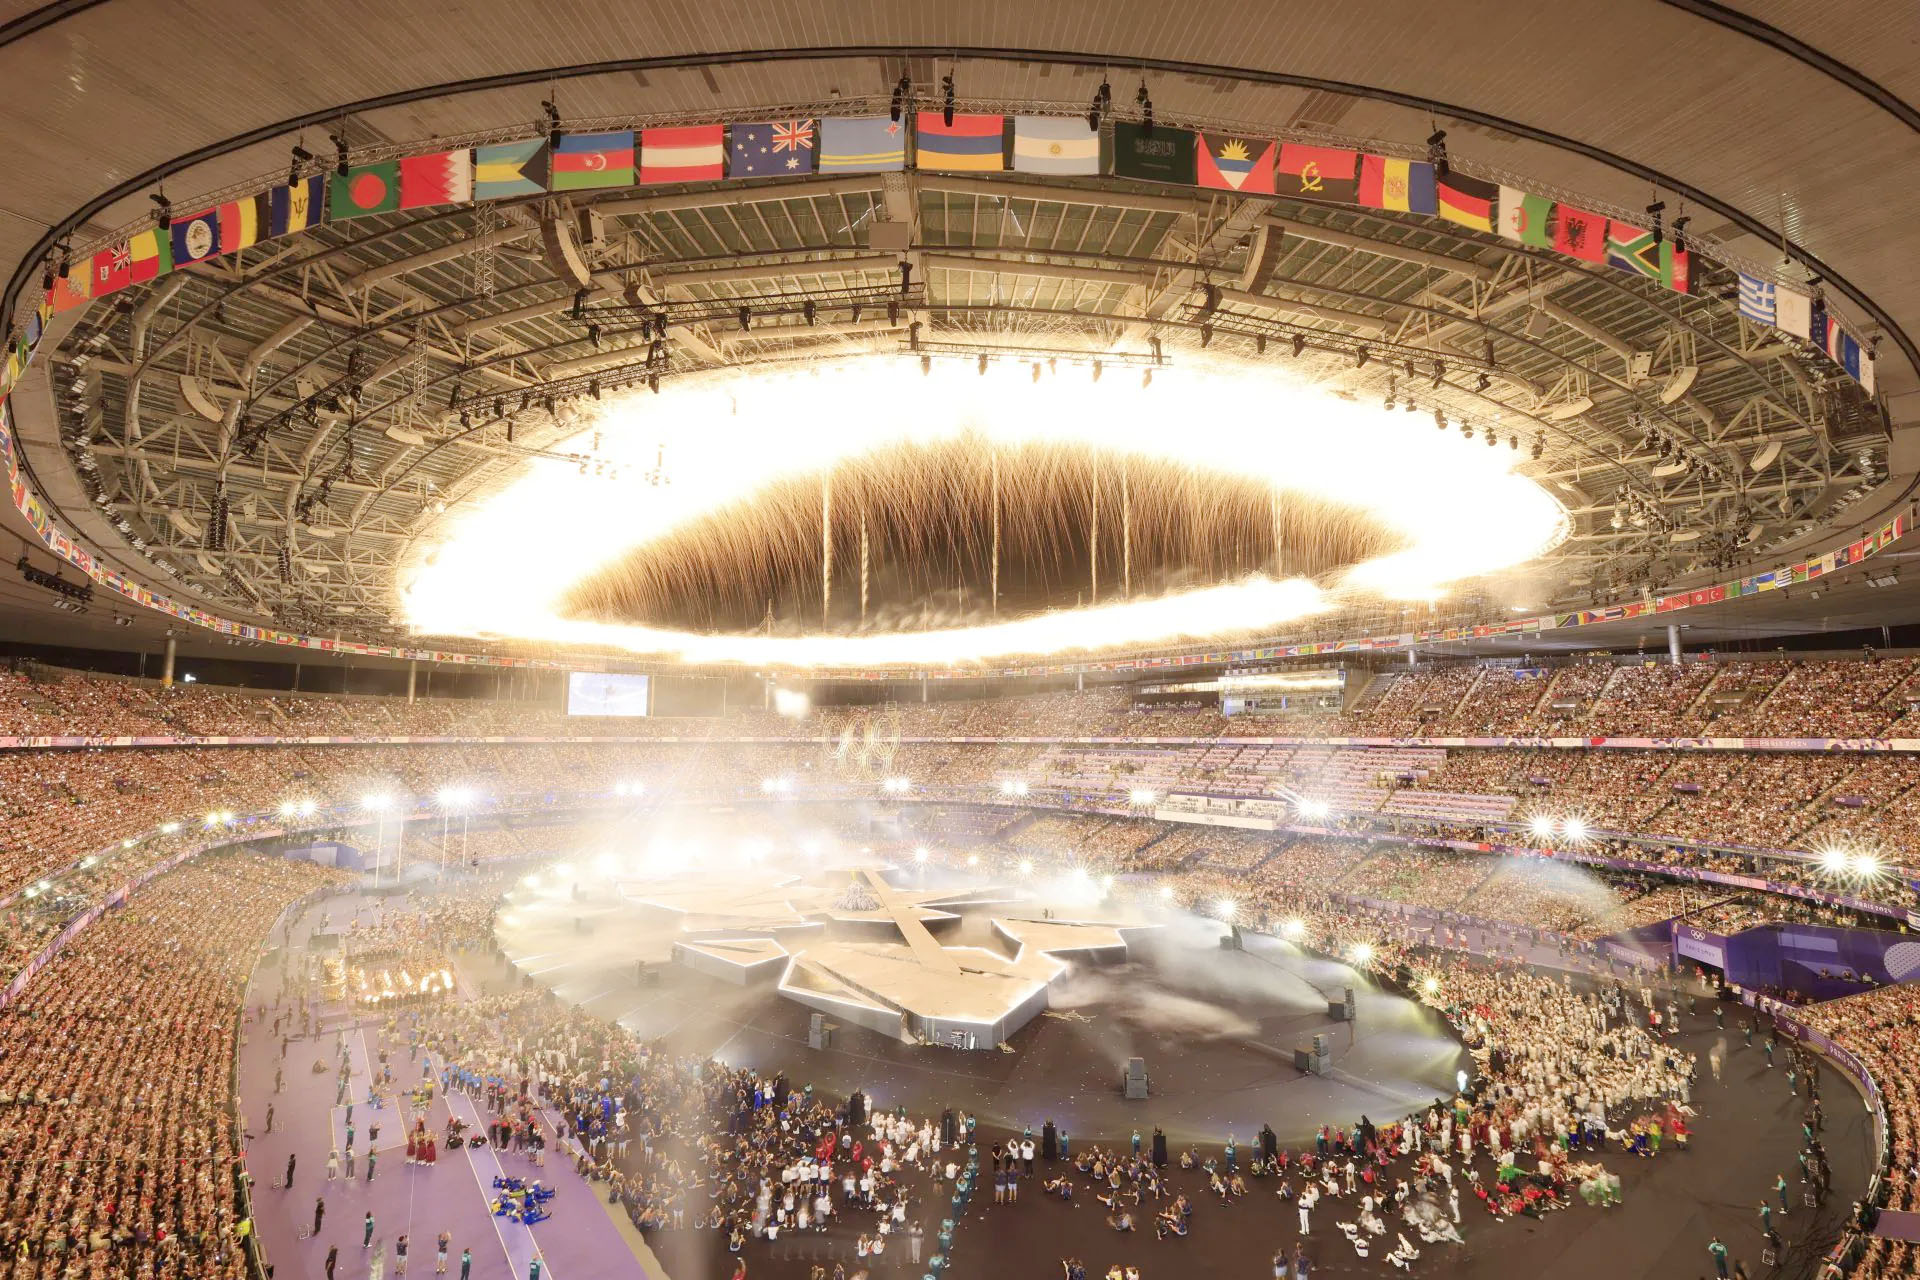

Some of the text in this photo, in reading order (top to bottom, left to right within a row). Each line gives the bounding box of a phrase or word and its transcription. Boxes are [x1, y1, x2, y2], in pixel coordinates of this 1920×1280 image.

[1854, 900, 1892, 914] PARIS 2024
[1830, 1045, 1847, 1063] PARIS
